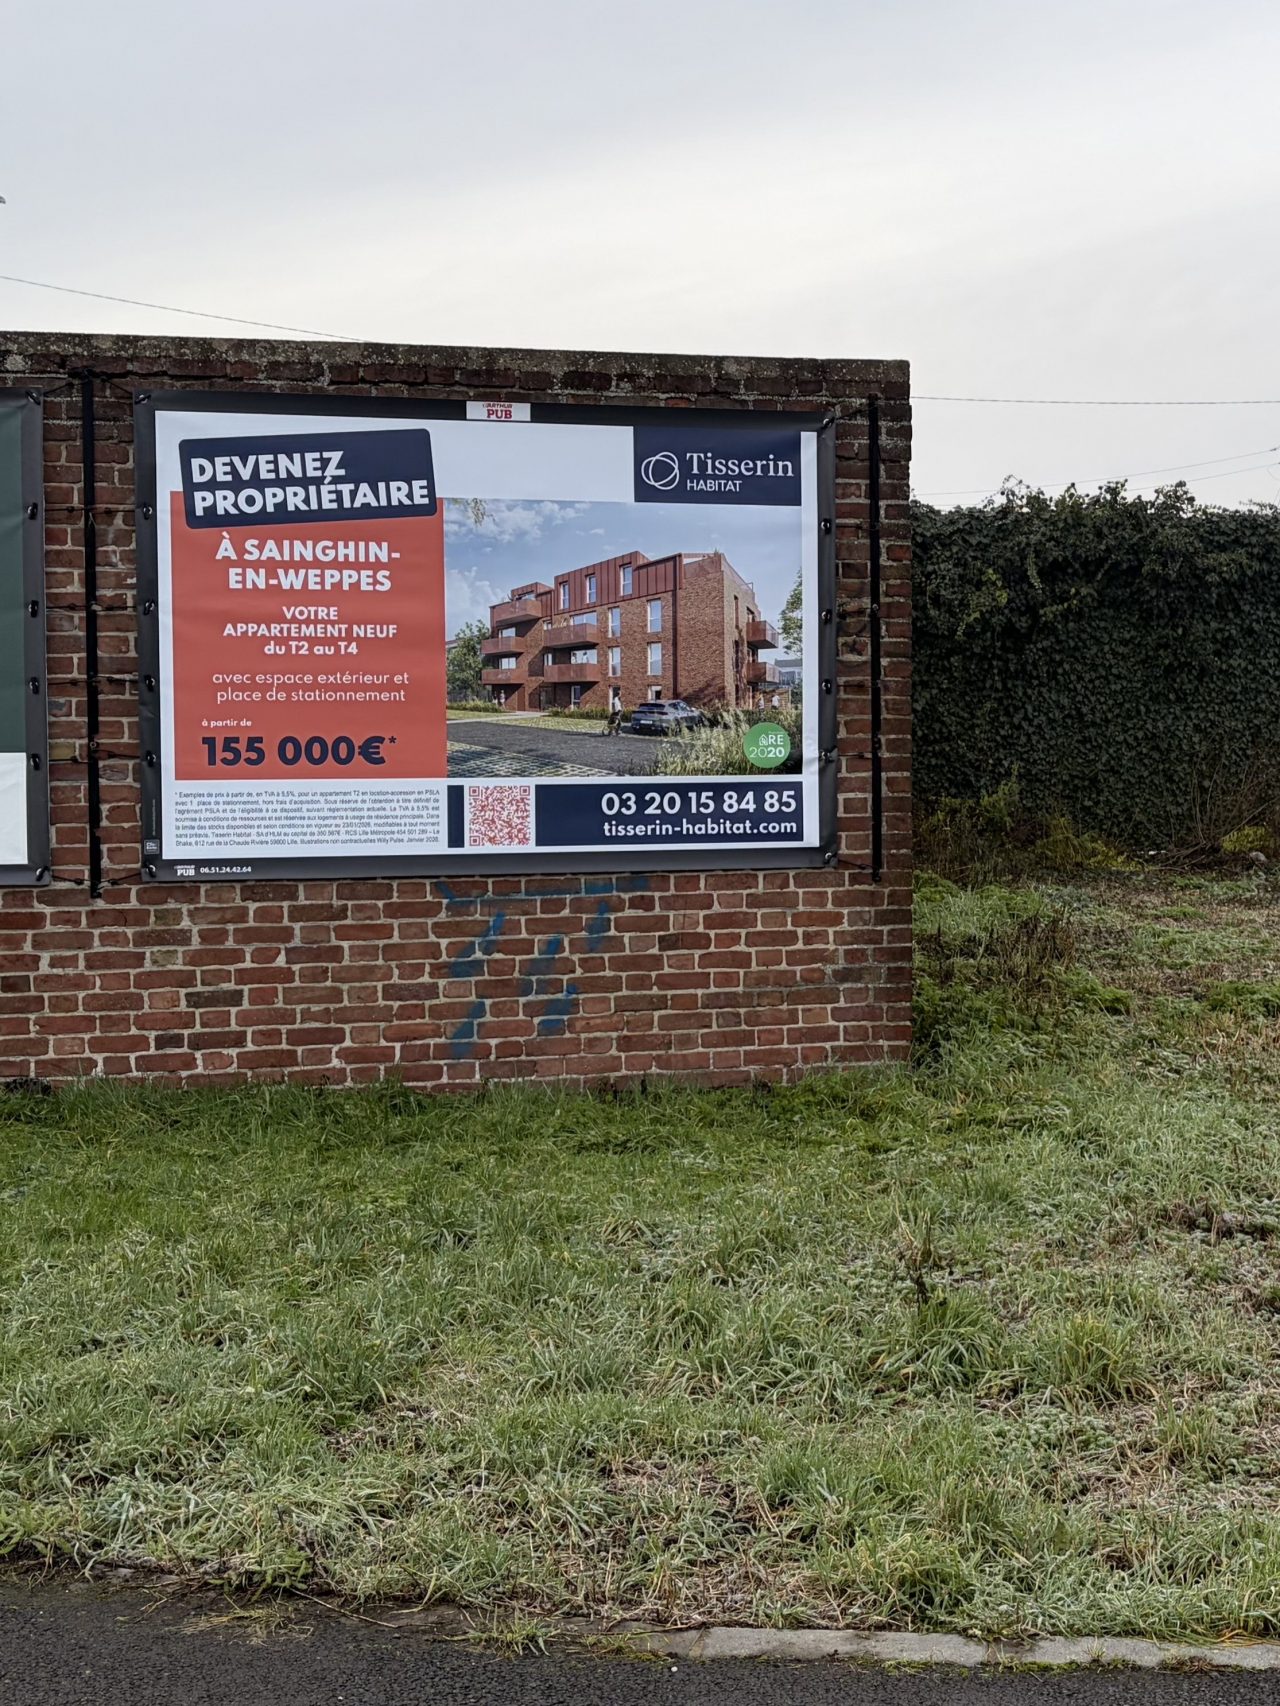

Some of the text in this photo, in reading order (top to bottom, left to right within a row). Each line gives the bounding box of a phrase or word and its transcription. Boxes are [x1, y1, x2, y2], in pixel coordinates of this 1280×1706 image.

[487, 409, 512, 419] PUB
[190, 451, 345, 483] DEVENEZ
[686, 452, 794, 477] Tisserin
[687, 480, 742, 492] HABITAT
[193, 477, 429, 516] PROPRIÉTAIRE
[215, 531, 401, 563] À SAINGHIN-
[228, 567, 392, 591] EN-WEPPES
[282, 606, 338, 620] VOTRE
[223, 623, 398, 639] APPARTEMENT NEUF
[264, 641, 359, 655] du T2 au T4
[212, 670, 409, 688] avec espace extérieur et
[217, 687, 406, 704] place de stationnement
[201, 718, 252, 729] à partir de
[768, 735, 784, 745] RE
[201, 735, 265, 766] 155
[749, 747, 785, 758] 2020
[601, 790, 796, 815] 03 20 15 84 85
[603, 818, 797, 836] tisserin-habitat.com
[177, 866, 252, 876] PUB 06.51.24.42.64
